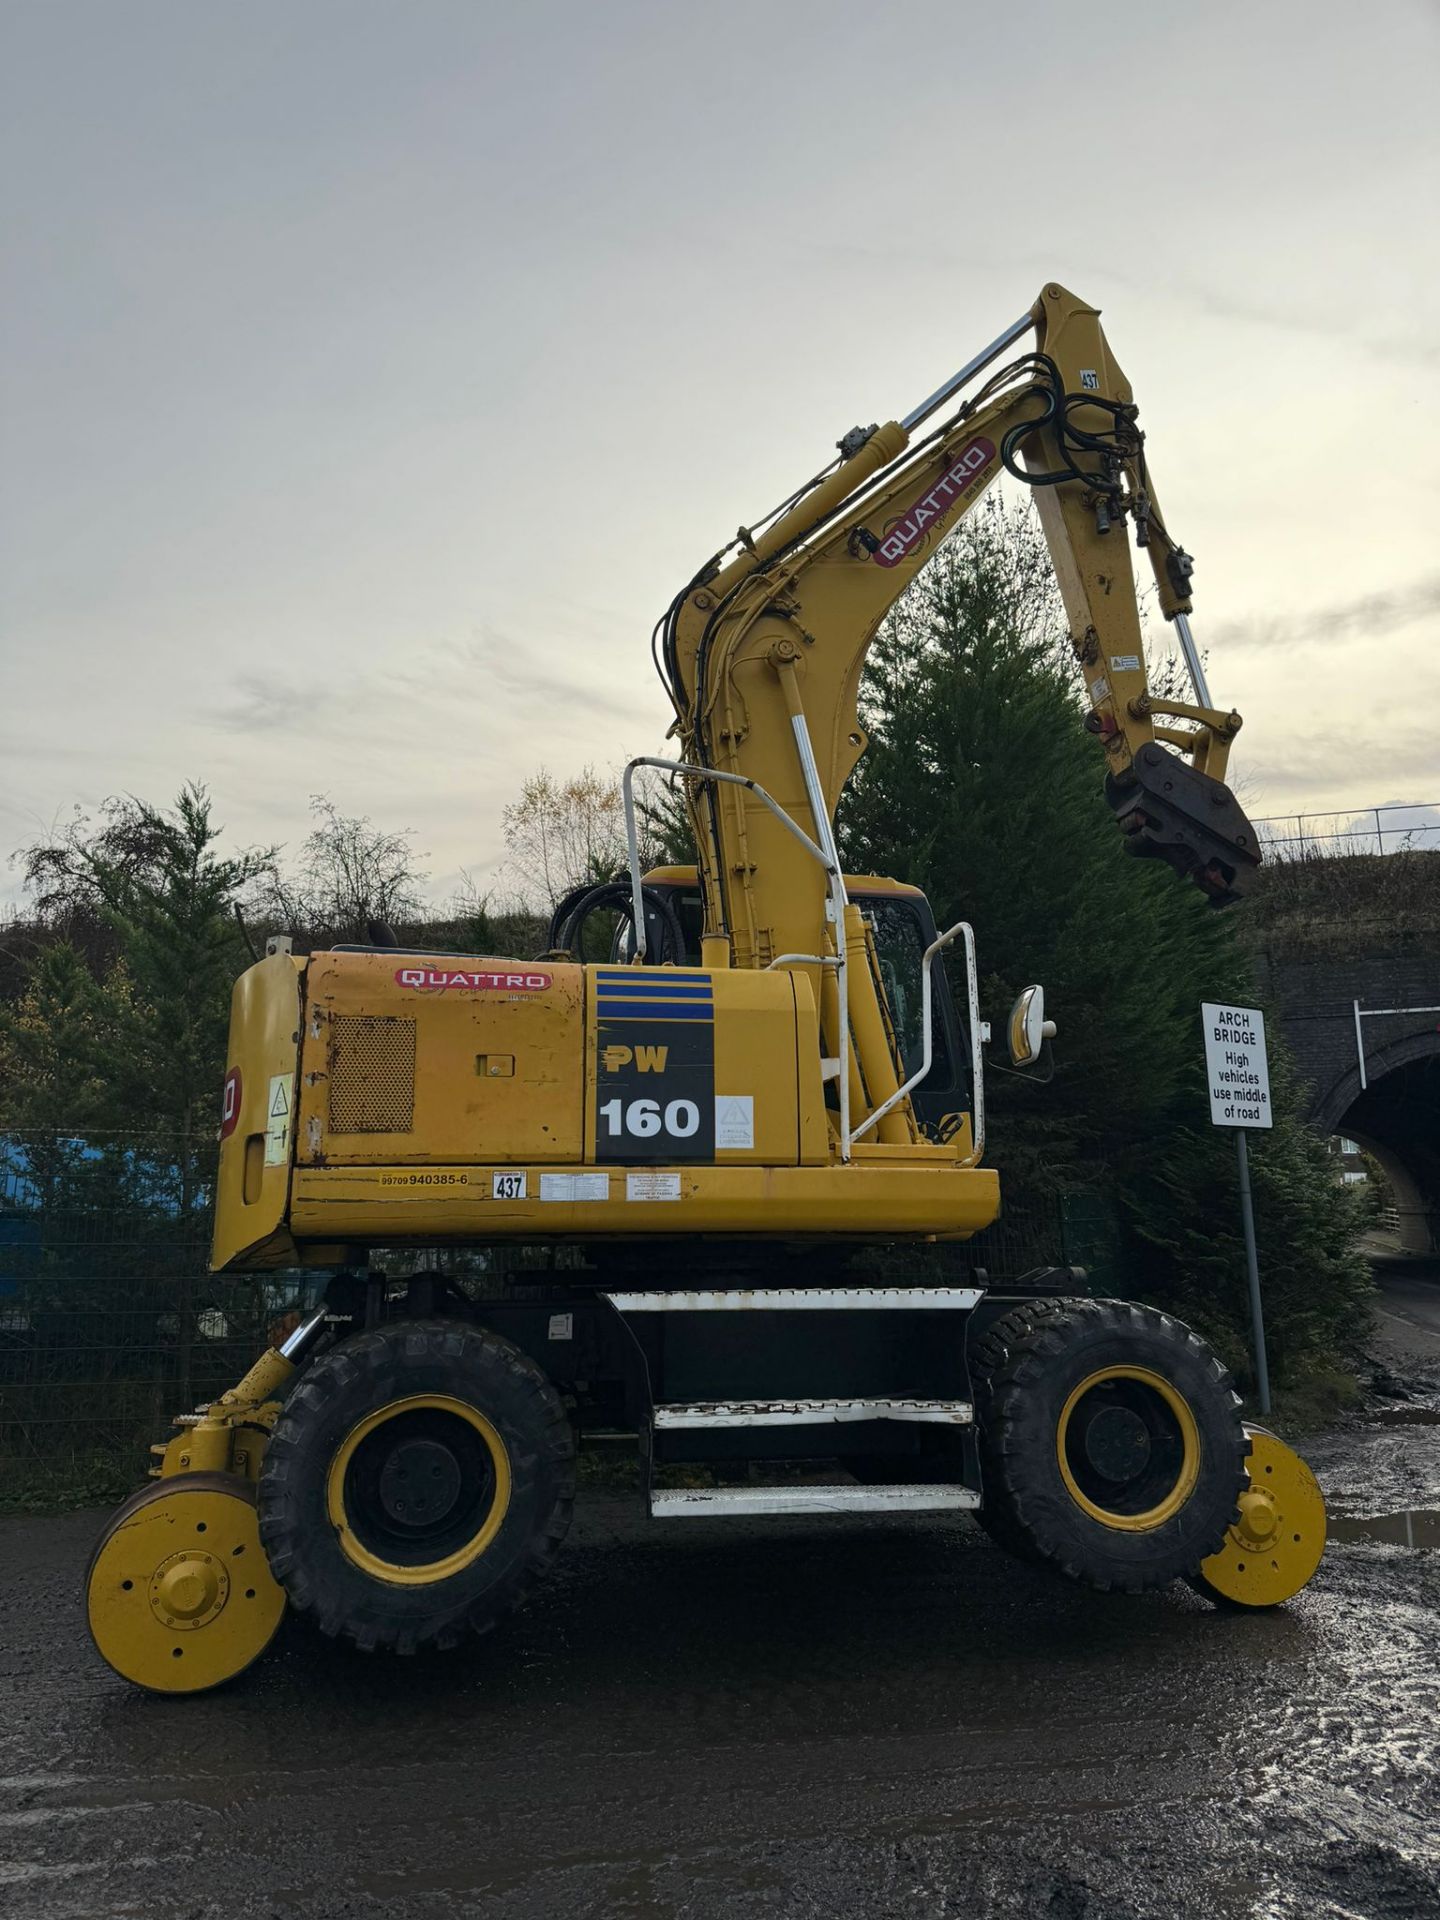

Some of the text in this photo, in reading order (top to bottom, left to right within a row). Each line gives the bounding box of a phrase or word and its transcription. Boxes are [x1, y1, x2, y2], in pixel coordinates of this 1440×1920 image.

[1082, 373, 1098, 389] 437
[880, 446, 986, 560] QUATTRO
[401, 970, 545, 987] QUATTRO
[1218, 1011, 1250, 1028] ARCH
[1213, 1027, 1256, 1046] BRIDGE
[605, 1045, 669, 1073] PW
[1225, 1051, 1250, 1068] High
[1218, 1070, 1260, 1085] vehicles
[1213, 1087, 1267, 1103] use middle
[600, 1099, 700, 1138] 160
[1224, 1105, 1260, 1120] of road
[496, 1177, 522, 1198] 437
